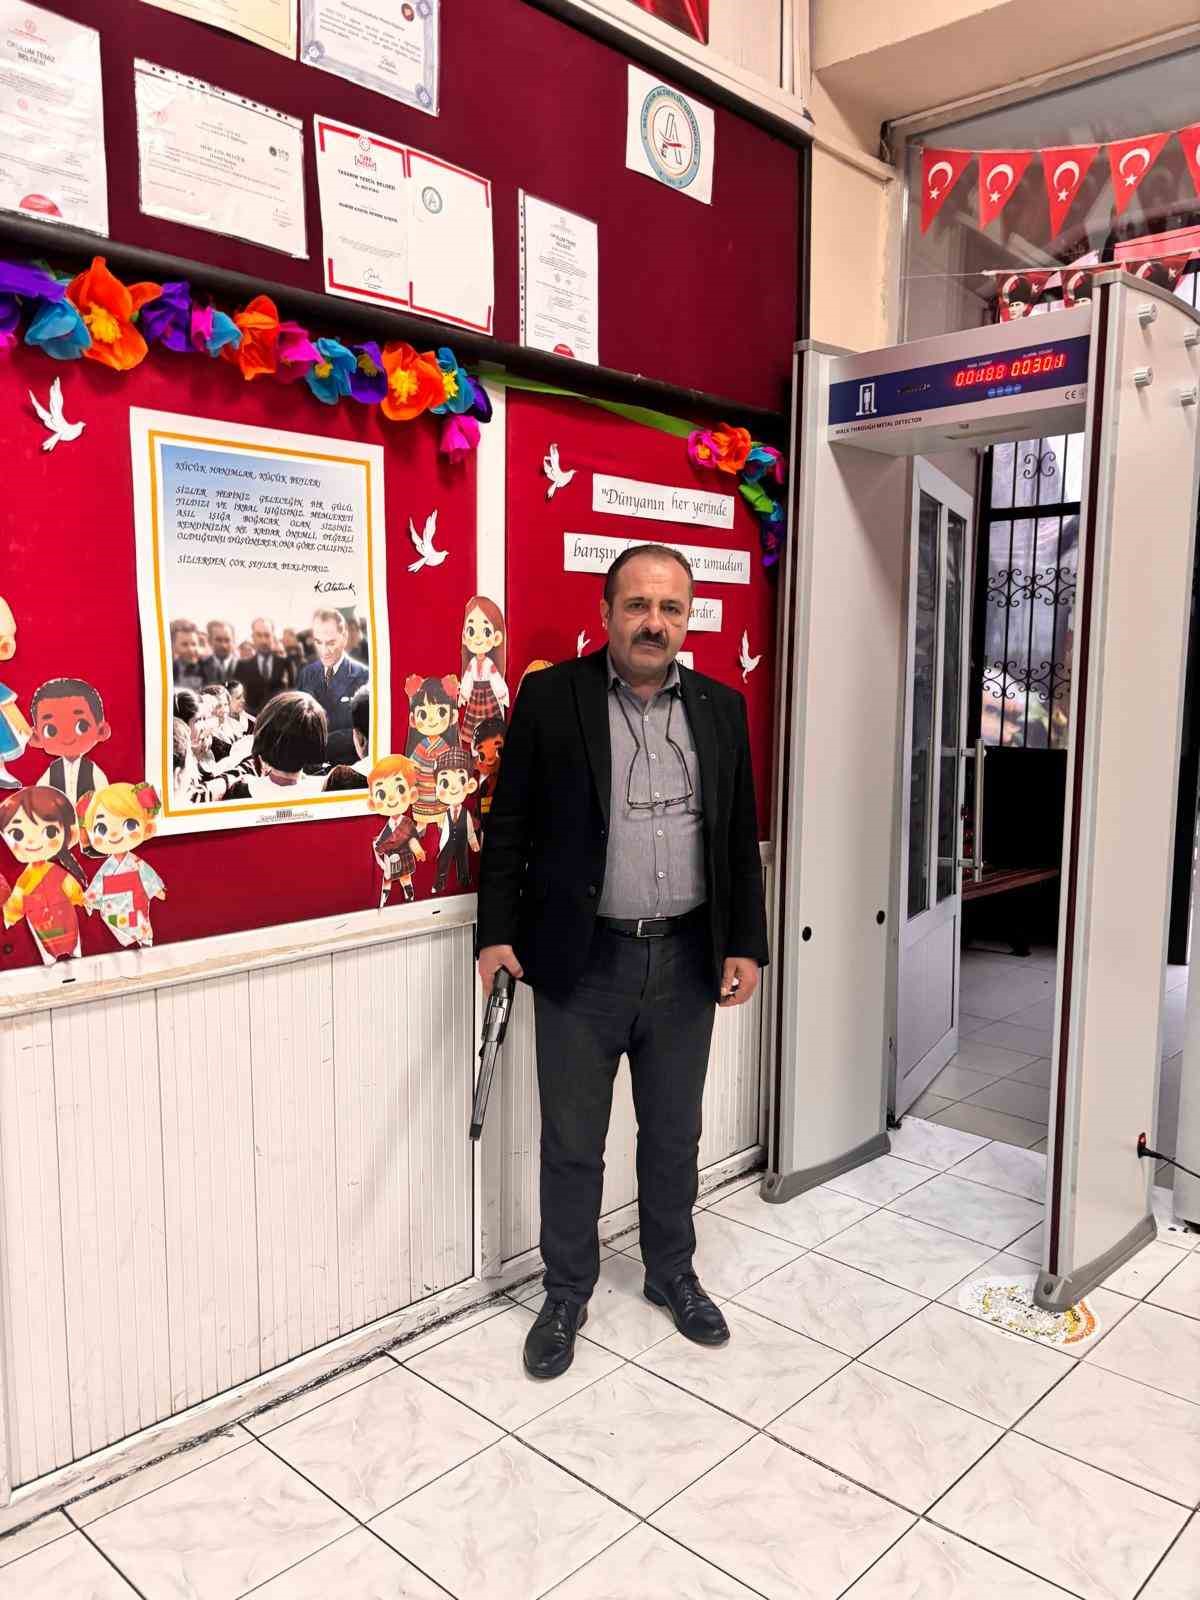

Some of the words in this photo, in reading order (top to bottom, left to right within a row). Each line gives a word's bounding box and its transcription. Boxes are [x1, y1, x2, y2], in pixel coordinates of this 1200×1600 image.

[894, 416, 923, 427] DETECTOR
[671, 491, 690, 511] her
[692, 497, 728, 519] yerinde
[704, 553, 744, 572] umudun
